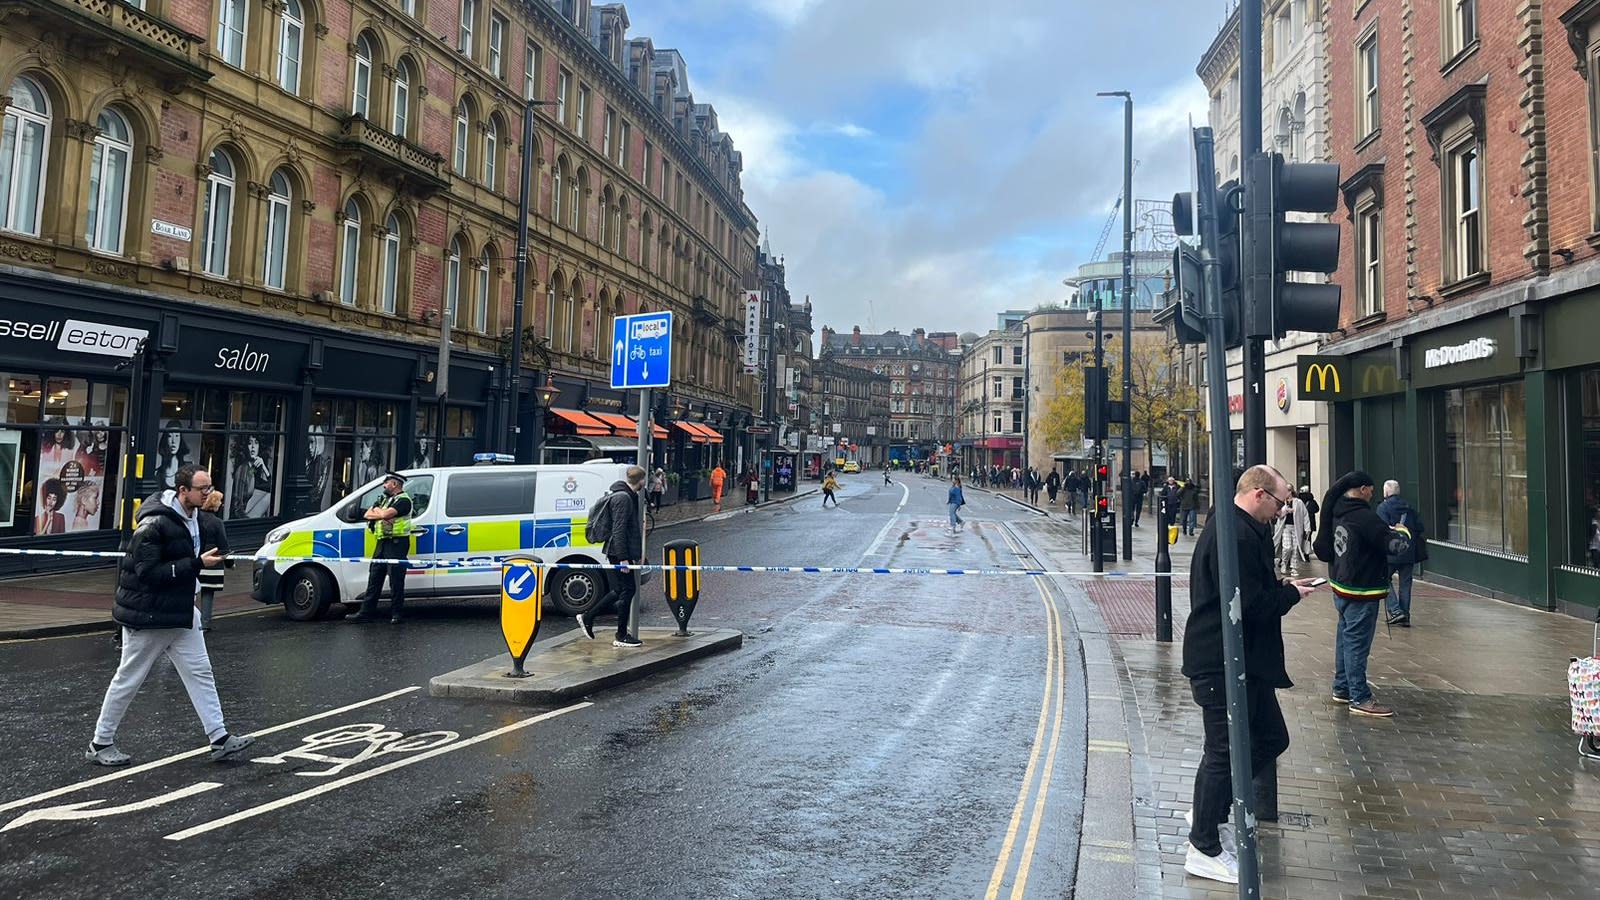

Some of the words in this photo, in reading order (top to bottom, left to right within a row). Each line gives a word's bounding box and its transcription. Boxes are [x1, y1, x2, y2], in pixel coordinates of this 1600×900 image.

[172, 227, 188, 238] LANE
[642, 321, 660, 332] local
[747, 305, 756, 363] MARRIOTT
[67, 328, 140, 350] eaton
[214, 342, 270, 372] salon
[648, 345, 663, 356] taxi
[1425, 337, 1494, 368] McDonald's
